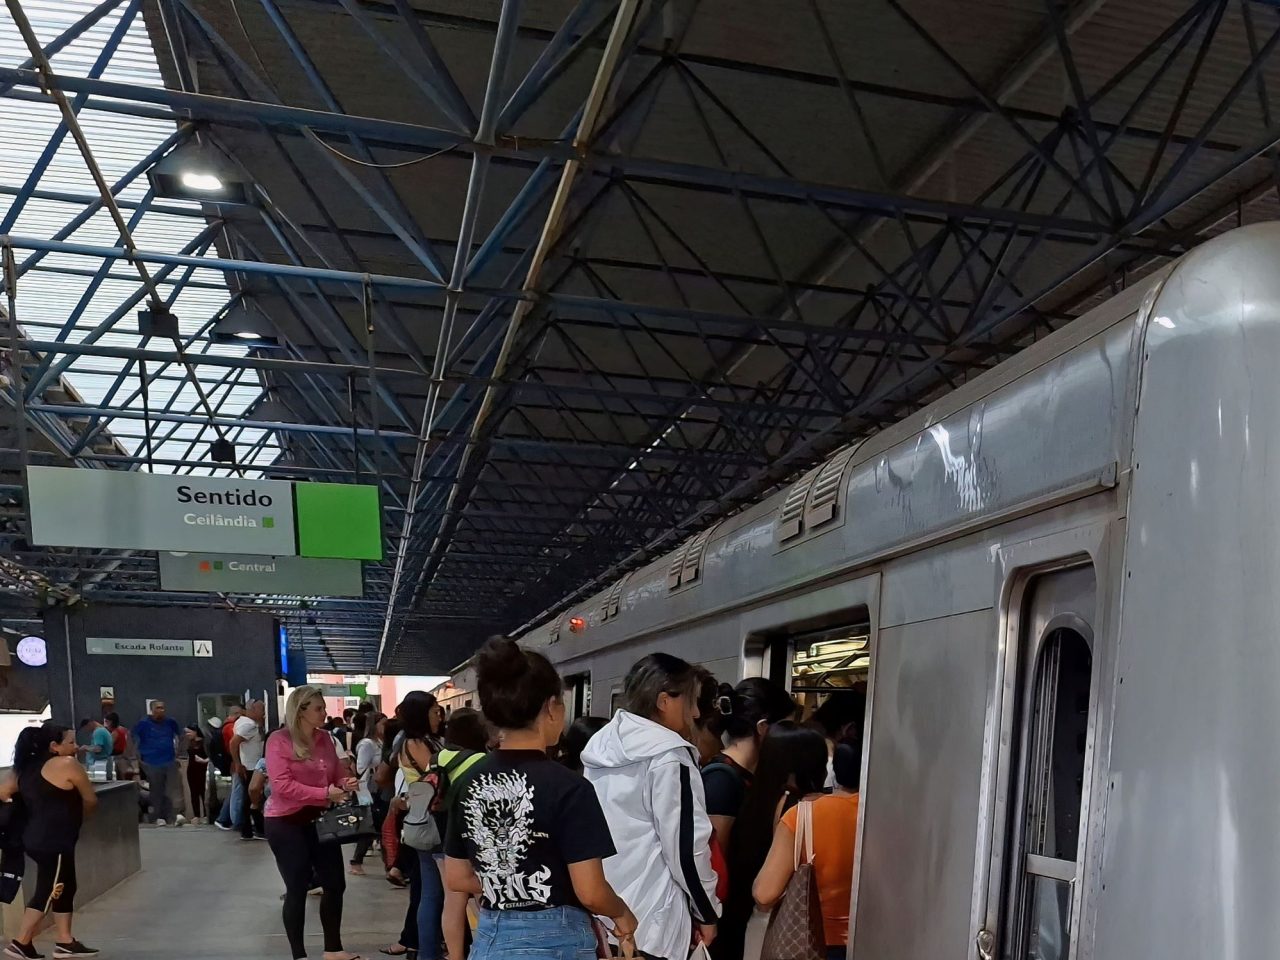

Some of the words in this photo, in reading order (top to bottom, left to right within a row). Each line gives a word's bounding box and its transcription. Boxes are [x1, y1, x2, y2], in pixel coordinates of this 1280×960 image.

[177, 485, 273, 507] Sentido
[183, 513, 257, 528] Ceilândia
[228, 561, 276, 572] Central
[149, 643, 184, 652] Rolante
